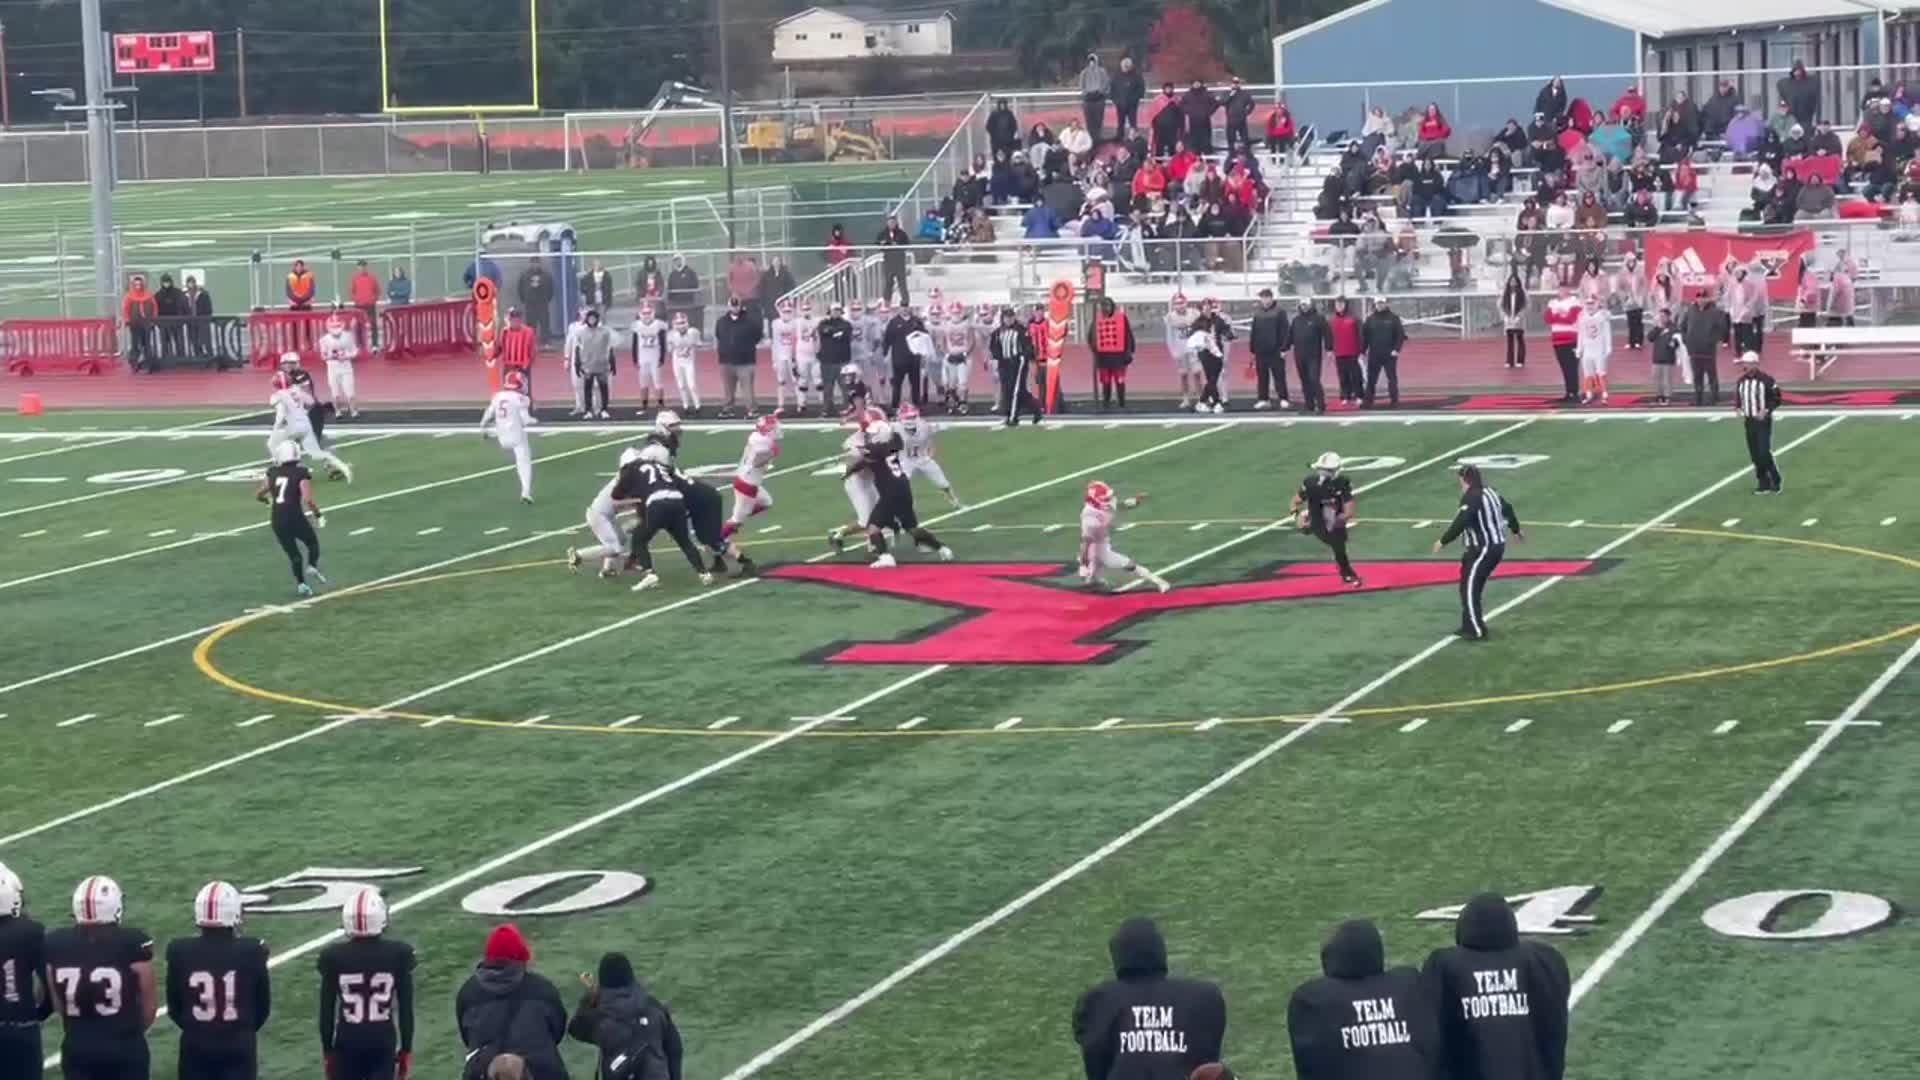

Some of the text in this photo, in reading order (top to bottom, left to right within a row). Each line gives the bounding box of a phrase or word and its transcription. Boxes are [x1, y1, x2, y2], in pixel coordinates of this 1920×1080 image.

[274, 477, 289, 503] 7
[55, 966, 123, 1016] 73
[1472, 968, 1518, 994] YELM
[189, 970, 240, 1021] 31
[339, 972, 395, 1023] 52
[1461, 993, 1529, 1018] FOOTBALL
[1131, 1006, 1174, 1029] YELM
[1352, 997, 1395, 1022] YELM
[1120, 1030, 1188, 1053] FOOTBALL
[1341, 1021, 1411, 1048] FOOTBALL
